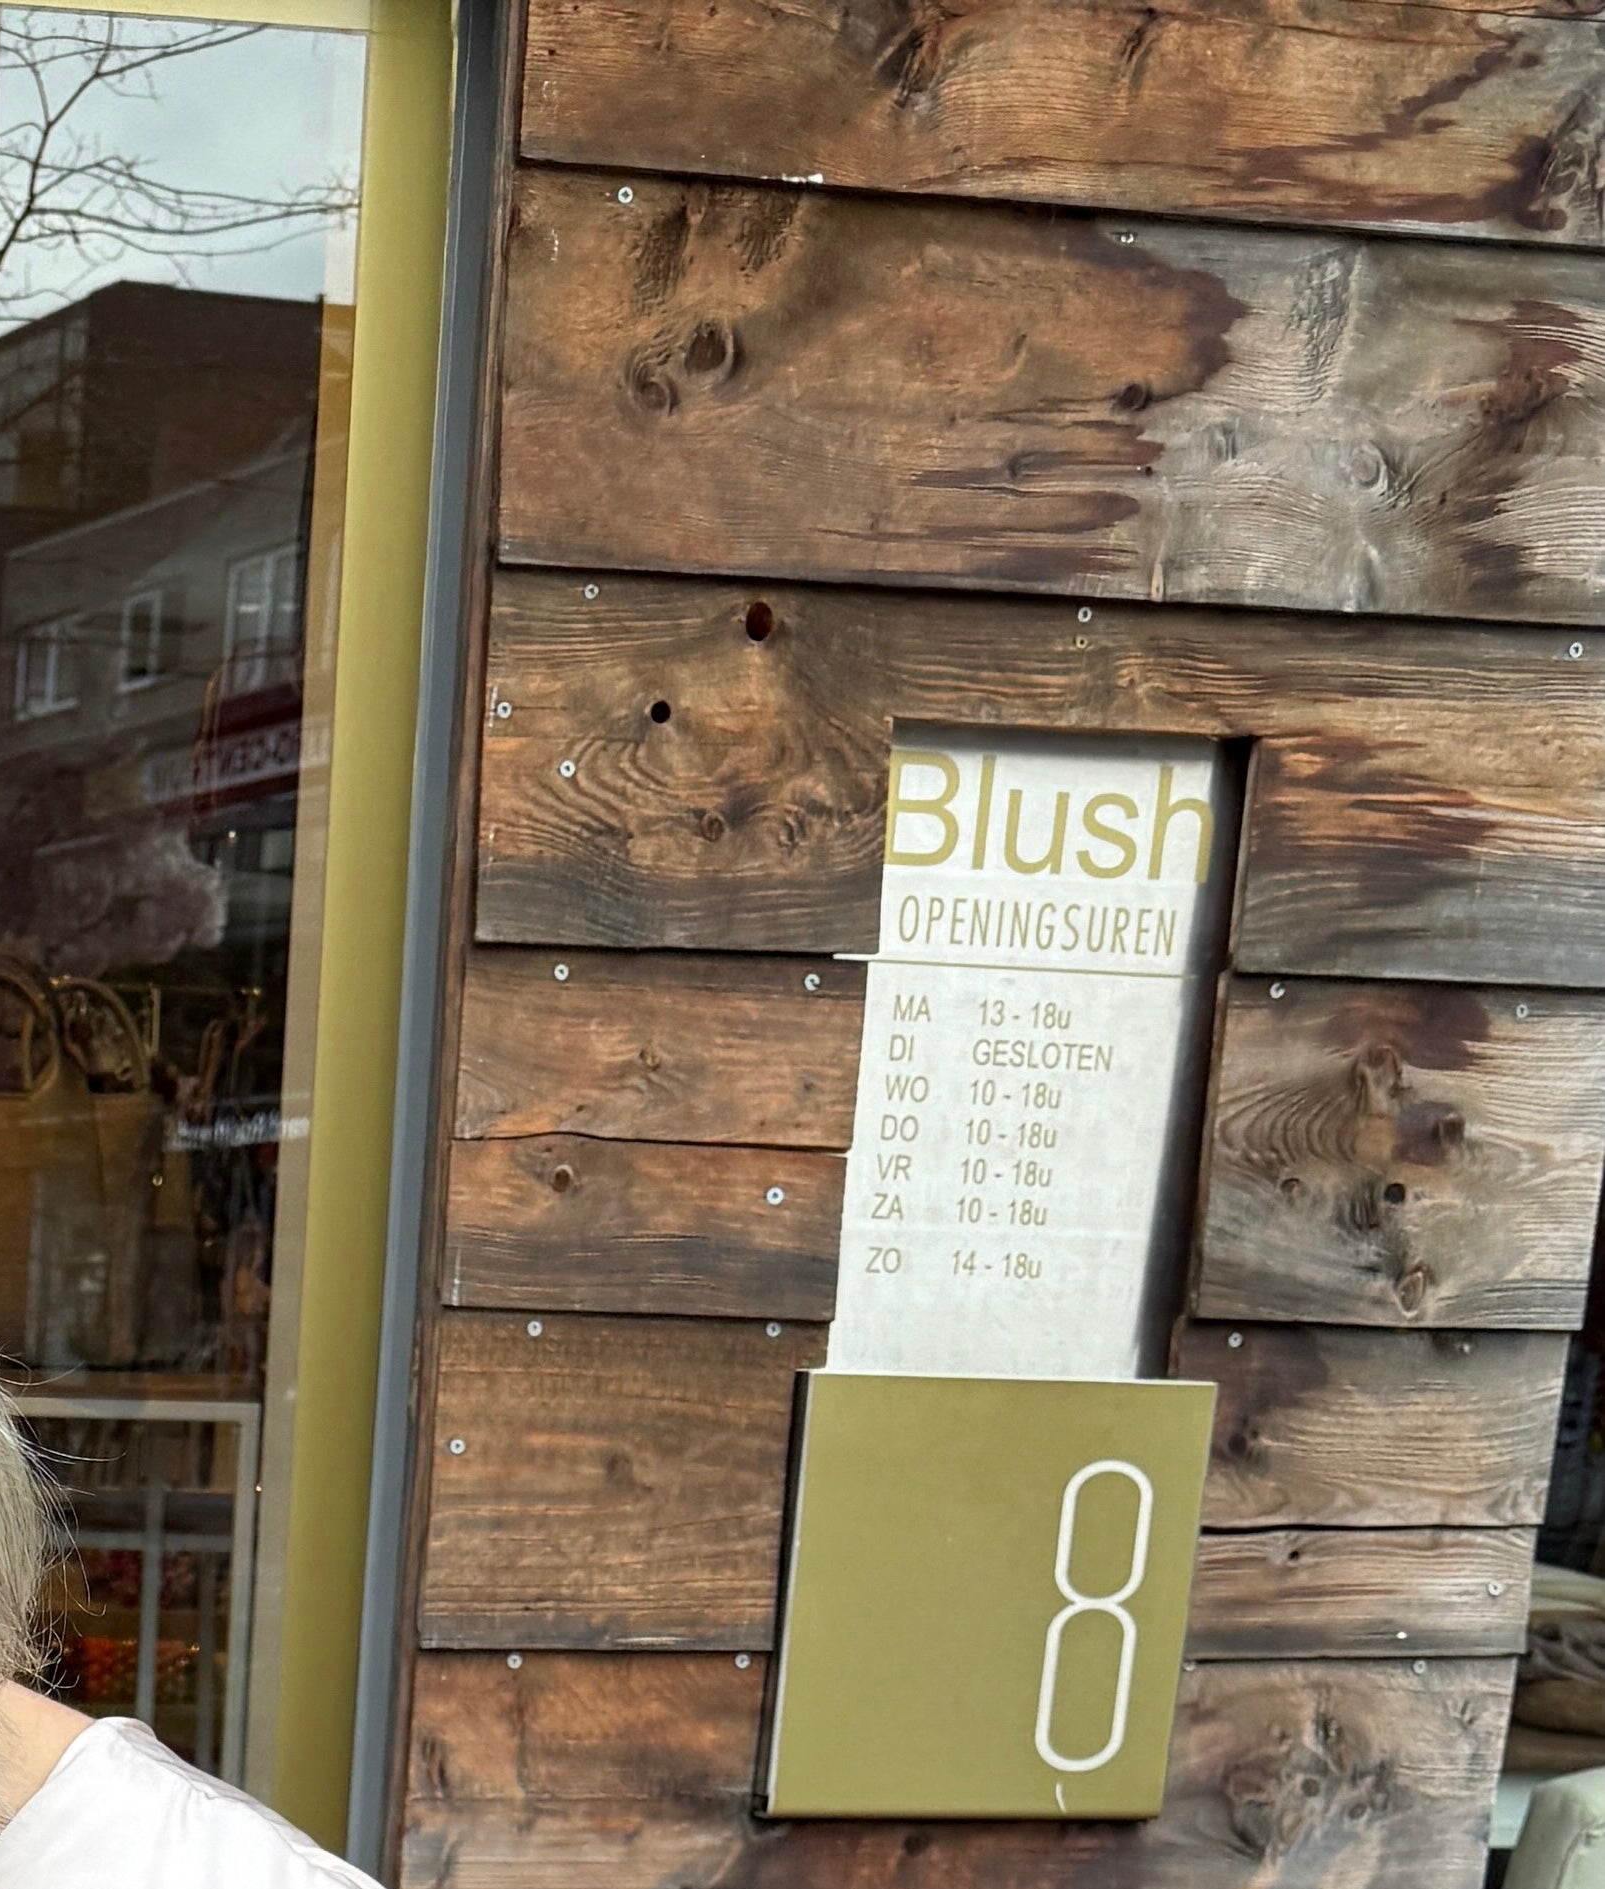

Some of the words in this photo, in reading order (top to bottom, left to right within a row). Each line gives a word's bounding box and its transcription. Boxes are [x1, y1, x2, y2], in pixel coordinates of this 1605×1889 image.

[883, 749, 1215, 885] Blush
[898, 894, 1177, 956] OPENINGSUREN
[892, 994, 932, 1023] MA
[979, 999, 1006, 1027] 13
[1032, 1002, 1072, 1030] 18u
[888, 1034, 915, 1062] DI
[971, 1038, 1113, 1072] GESLOTEN
[885, 1074, 930, 1103] WO
[969, 1079, 997, 1107] 10
[1021, 1082, 1061, 1110] 18u
[880, 1114, 920, 1142] DO
[965, 1118, 992, 1146] 10
[1017, 1122, 1057, 1149] 18u
[877, 1153, 913, 1182] VR
[960, 1158, 987, 1185] 10
[1012, 1160, 1053, 1187] 18u
[870, 1192, 905, 1221] ZA
[956, 1197, 983, 1224] 10
[1008, 1199, 1048, 1226] 18u
[865, 1246, 902, 1274] ZO
[952, 1249, 978, 1276] 14
[1003, 1252, 1043, 1280] 18u
[1035, 1459, 1154, 1773] 8
